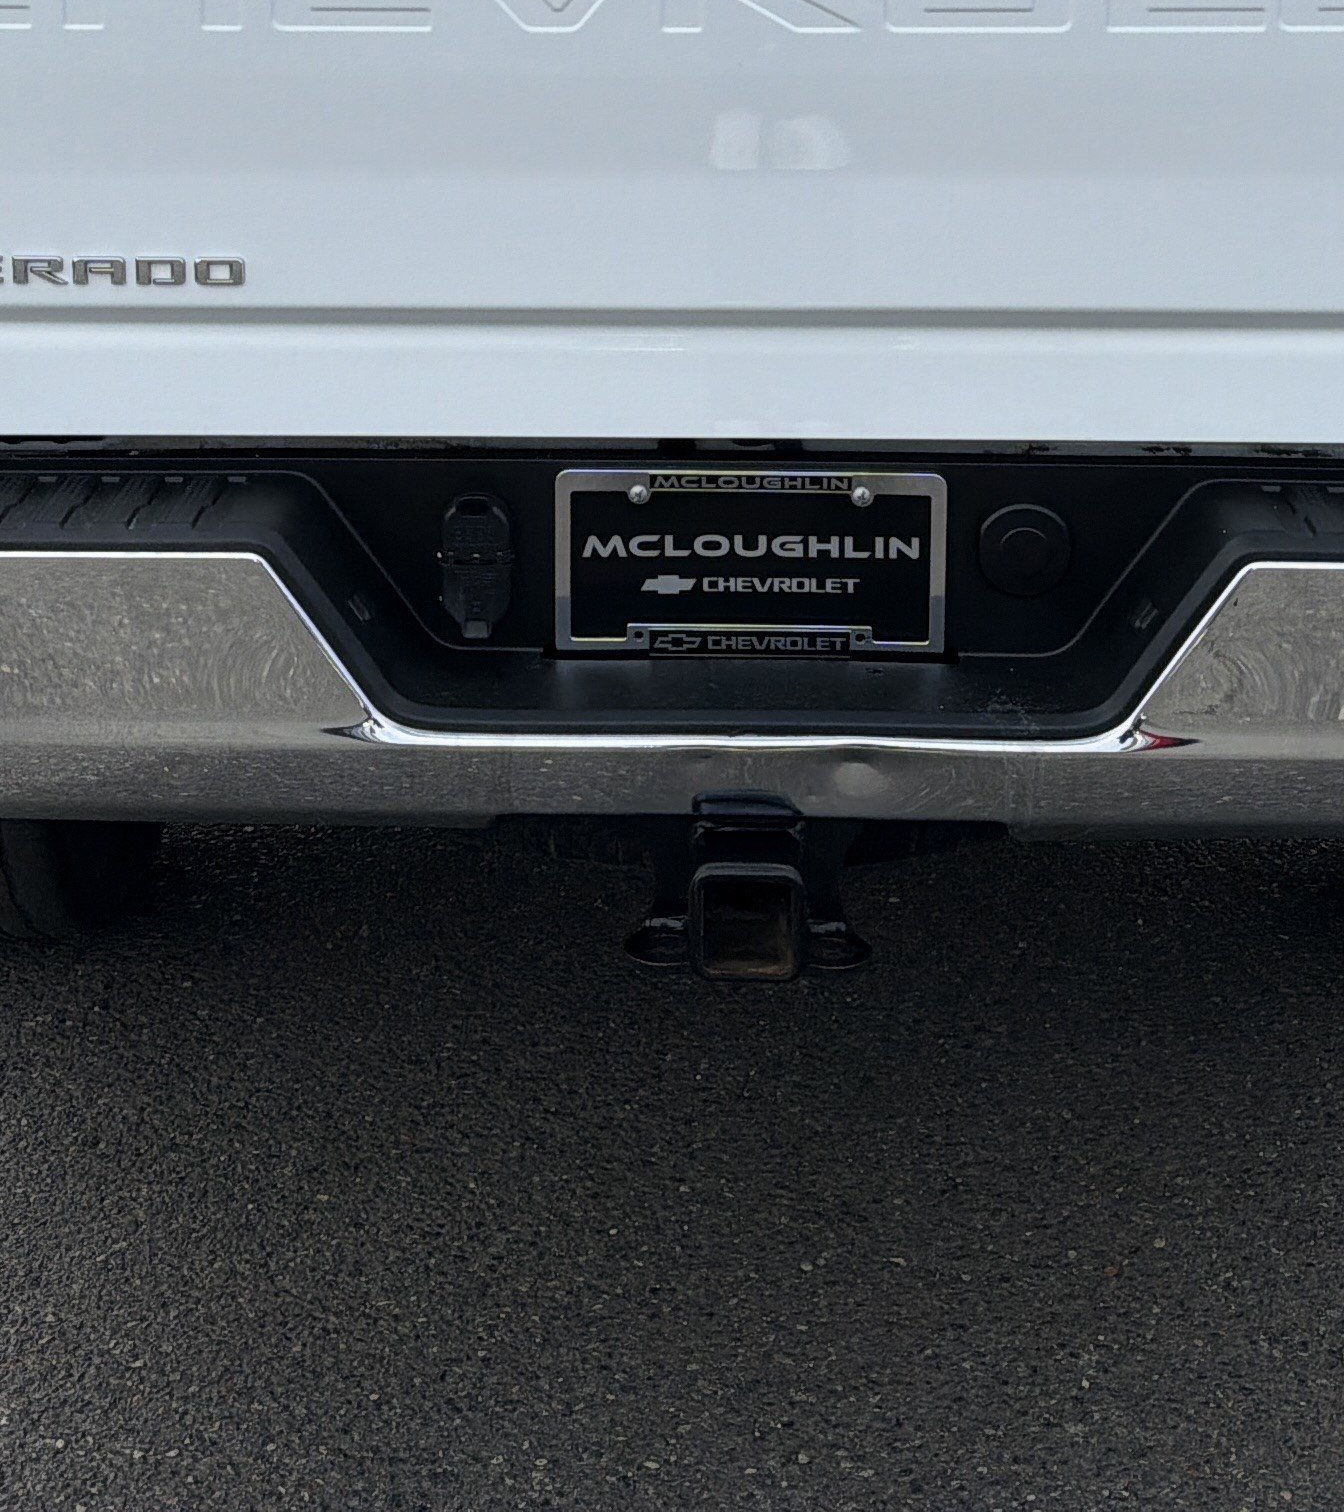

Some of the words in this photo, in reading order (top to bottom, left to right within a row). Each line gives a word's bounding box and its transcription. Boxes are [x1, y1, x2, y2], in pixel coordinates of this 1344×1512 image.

[653, 475, 850, 490] MCLOUGHLIN
[581, 534, 921, 560] MCLOUGHLIN
[702, 576, 861, 594] CHEVROLET
[706, 635, 847, 651] CHEVROLET
